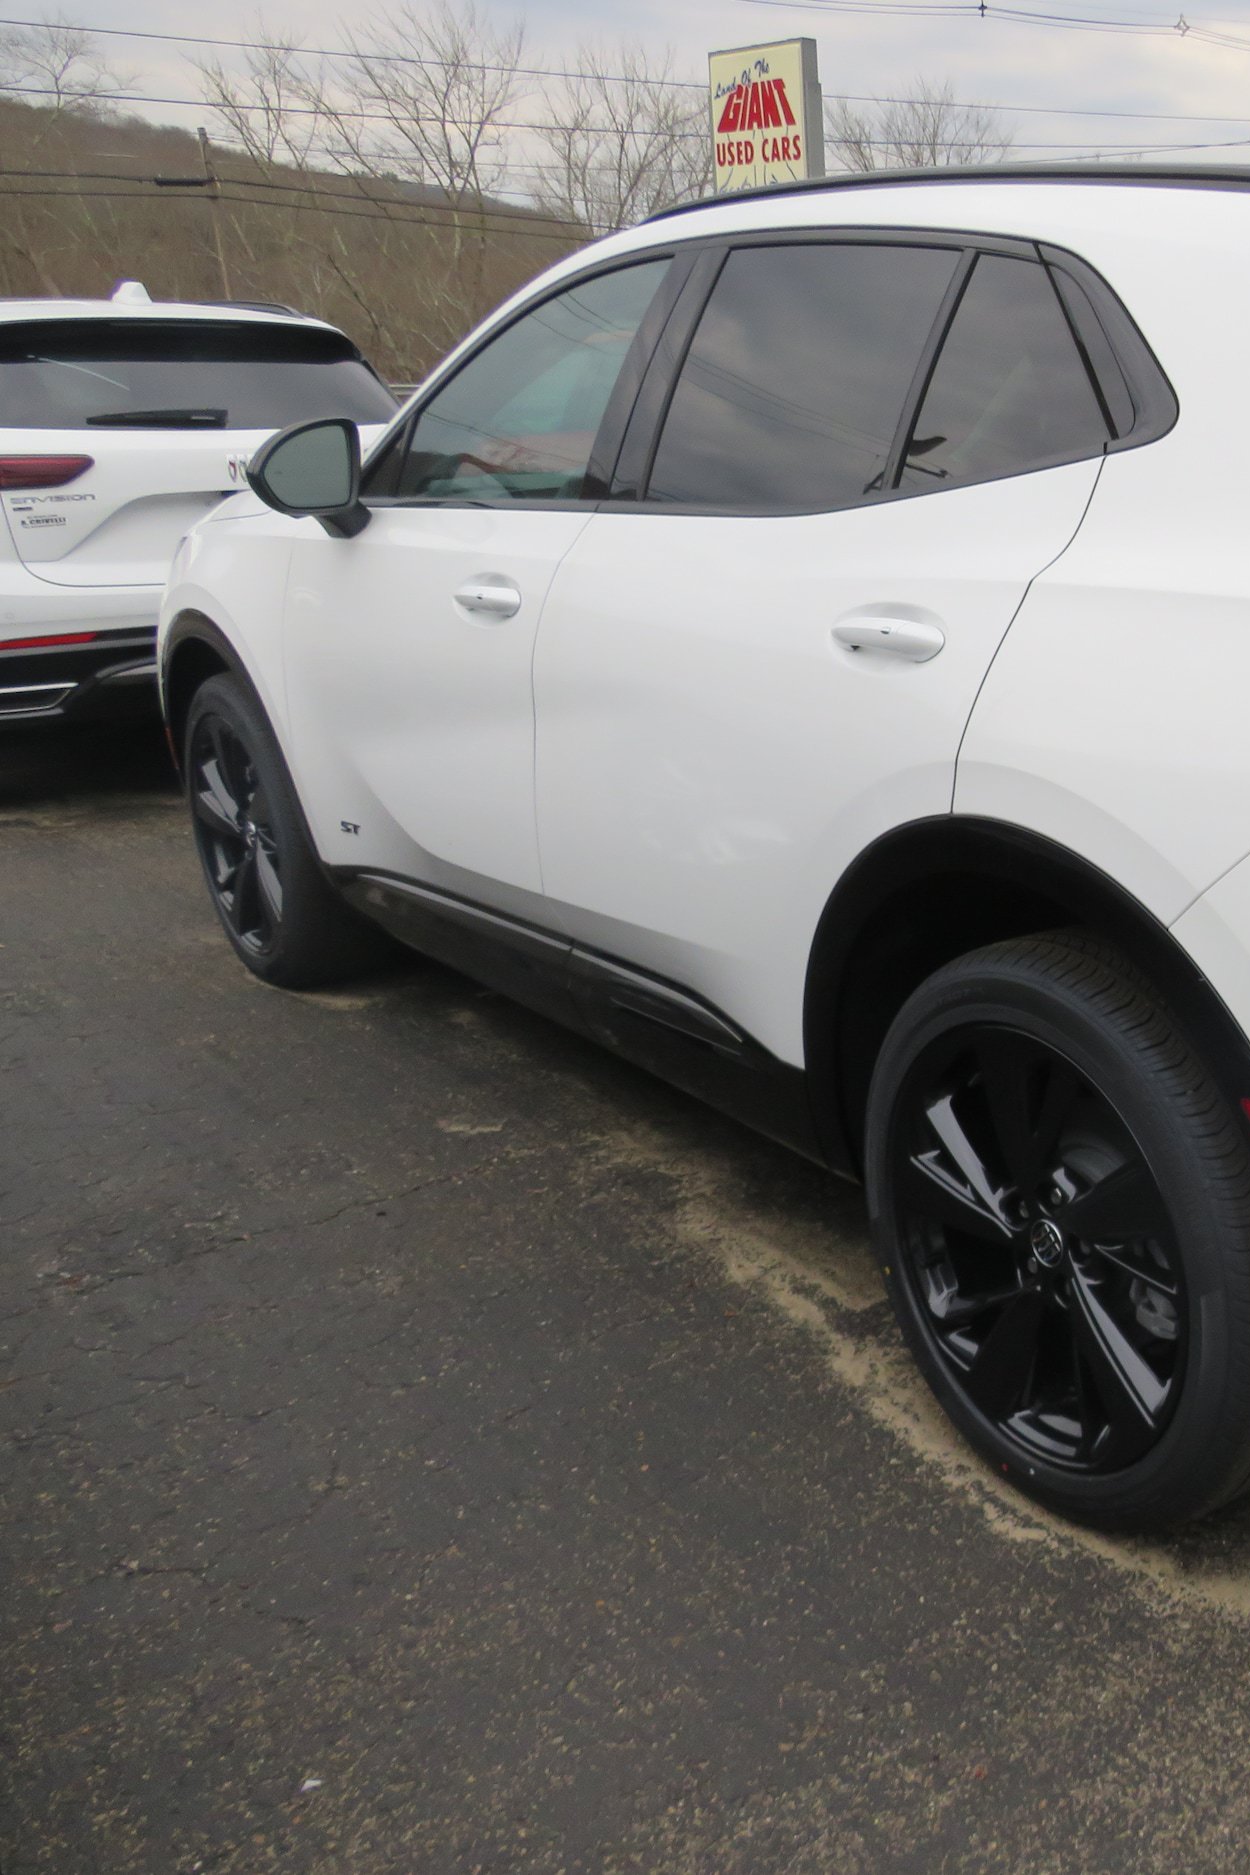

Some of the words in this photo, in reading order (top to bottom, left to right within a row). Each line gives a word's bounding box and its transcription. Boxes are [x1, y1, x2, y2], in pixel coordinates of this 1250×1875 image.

[714, 76, 737, 99] Land
[754, 58, 769, 78] The
[718, 79, 796, 133] GIANT
[716, 141, 754, 167] USED
[762, 135, 801, 162] CARS
[341, 821, 360, 835] ST
